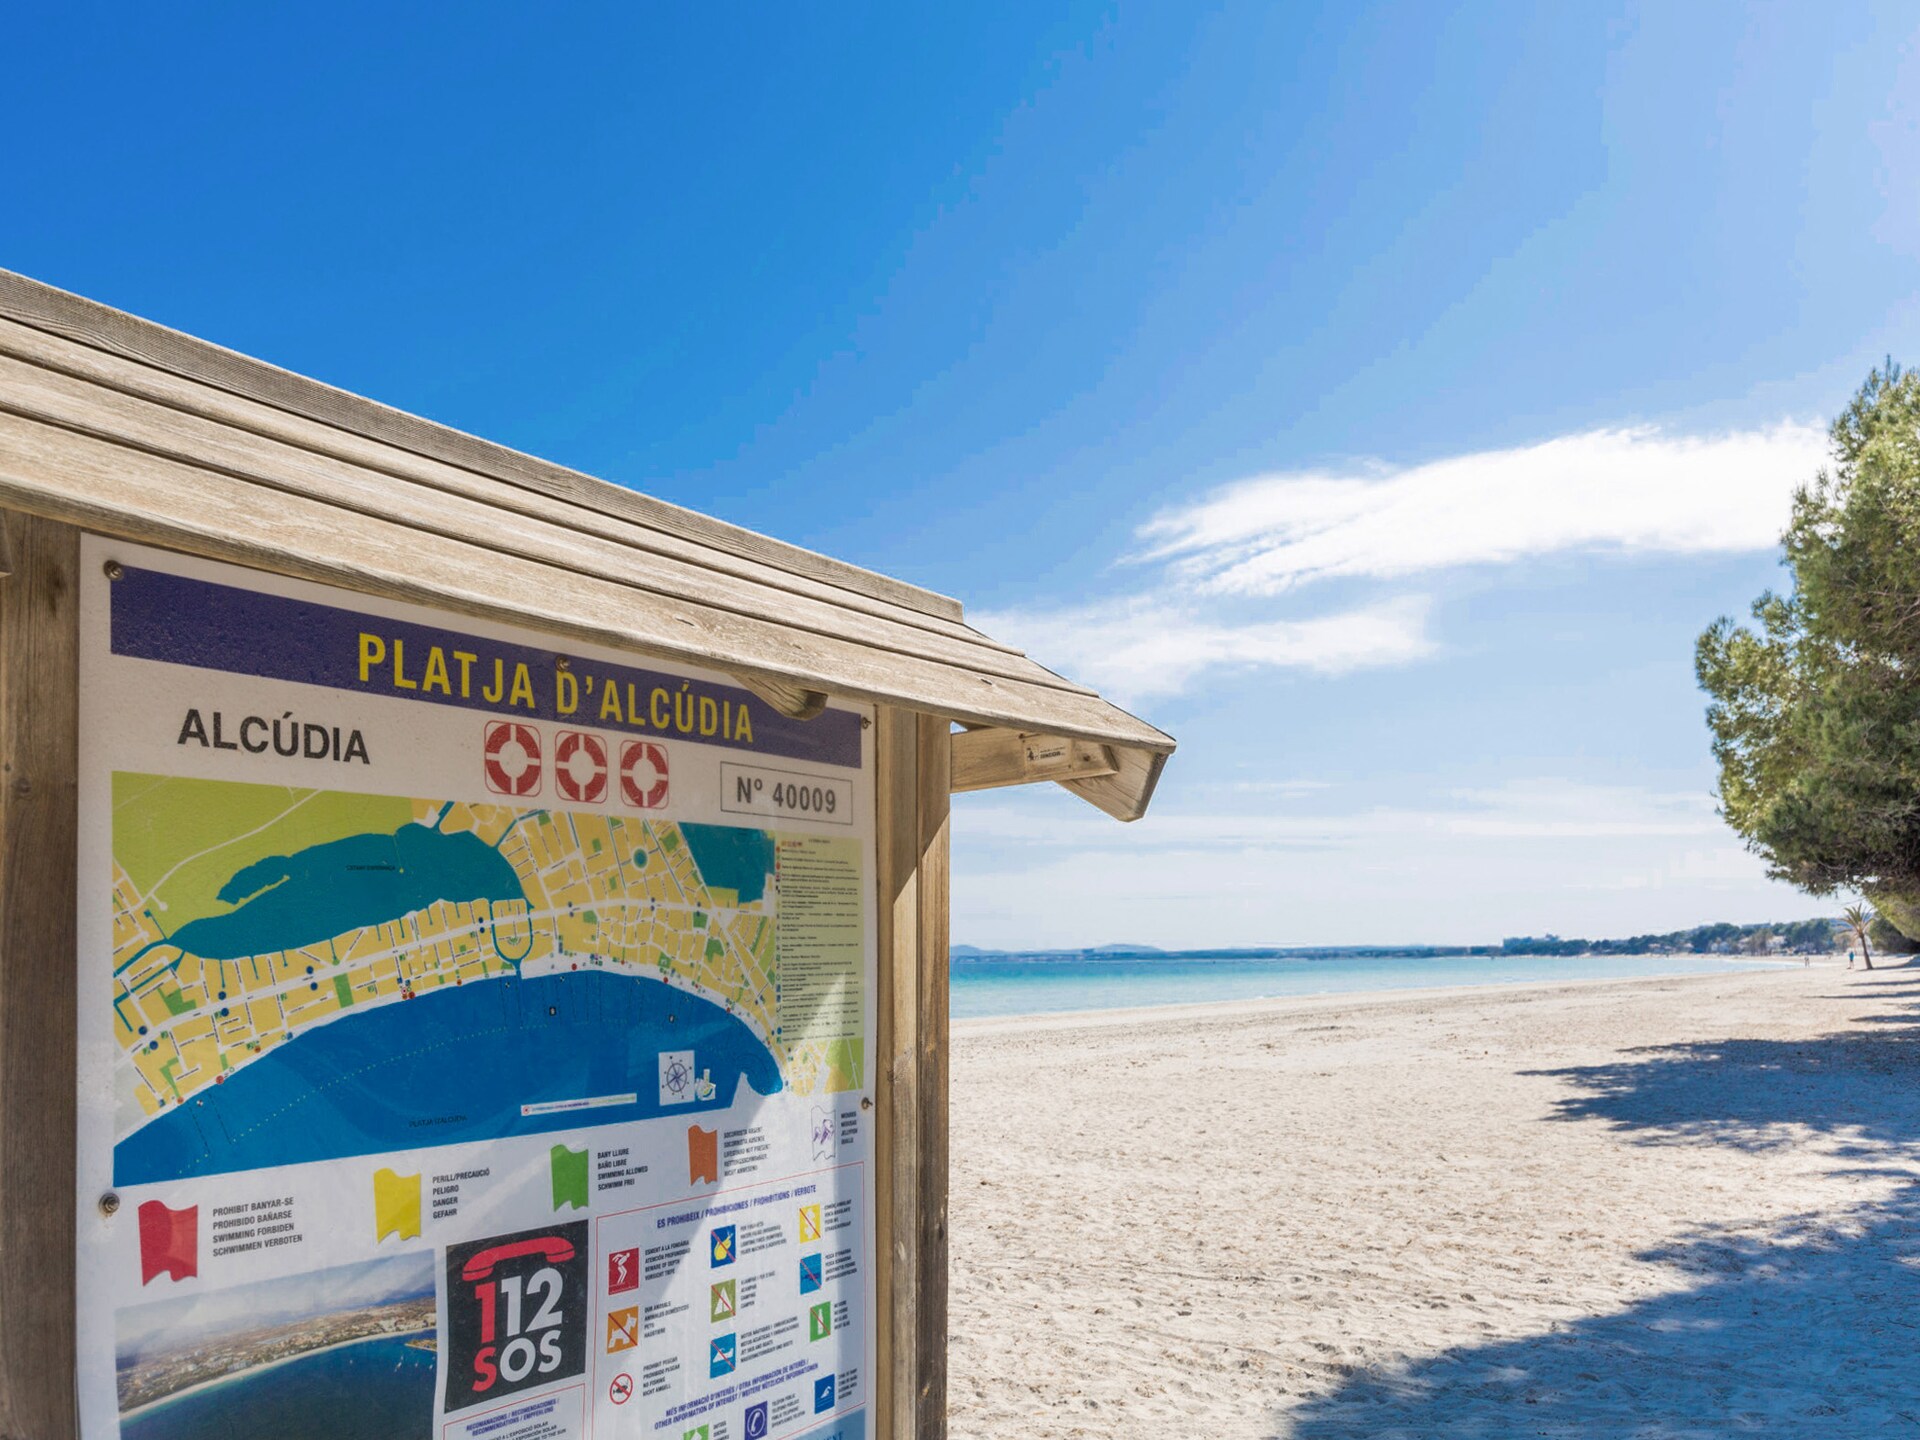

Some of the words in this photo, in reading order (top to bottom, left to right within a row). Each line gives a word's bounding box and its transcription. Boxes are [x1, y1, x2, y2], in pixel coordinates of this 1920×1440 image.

[359, 632, 536, 709] PLATJA
[556, 671, 753, 743] D'ALCÚDIA
[177, 708, 370, 765] ALCÚDIA
[773, 782, 837, 814] 40009
[597, 1151, 611, 1159] BANY
[612, 1148, 629, 1157] LLIURE
[598, 1160, 612, 1170] BAÑO
[613, 1158, 627, 1167] LIBRE
[626, 1165, 648, 1175] ALLOWED
[432, 1167, 490, 1184] PERILL/PRECAUCIÓ
[624, 1178, 635, 1186] FREI
[433, 1184, 459, 1195] PELIGRO
[213, 1203, 249, 1217] PROHIBIT
[251, 1197, 294, 1211] BANYAR-SE
[433, 1196, 458, 1208] DANGER
[657, 1219, 665, 1229] ES
[667, 1210, 701, 1227] PROHIBEIX
[705, 1200, 749, 1218] PROHIBICIONES
[754, 1190, 790, 1207] PROHIBITIONS
[213, 1216, 255, 1230] PROHIBIDO
[257, 1210, 292, 1223] BAÑARSE
[213, 1229, 255, 1244] SWIMMING
[257, 1222, 295, 1236] FORBIDEN
[213, 1241, 262, 1257] SCHWIMMEN
[264, 1234, 303, 1248] VERBOTEN
[475, 1267, 563, 1344] 112
[472, 1330, 562, 1392] SOS
[655, 1418, 672, 1430] OTHER
[673, 1406, 707, 1424] INFORMATION
[708, 1403, 715, 1411] OF
[716, 1392, 738, 1408] INTEREST
[679, 1394, 710, 1413] INFORMACIÓ
[534, 1421, 549, 1429] SOLAR
[543, 1424, 557, 1433] SOLAR
